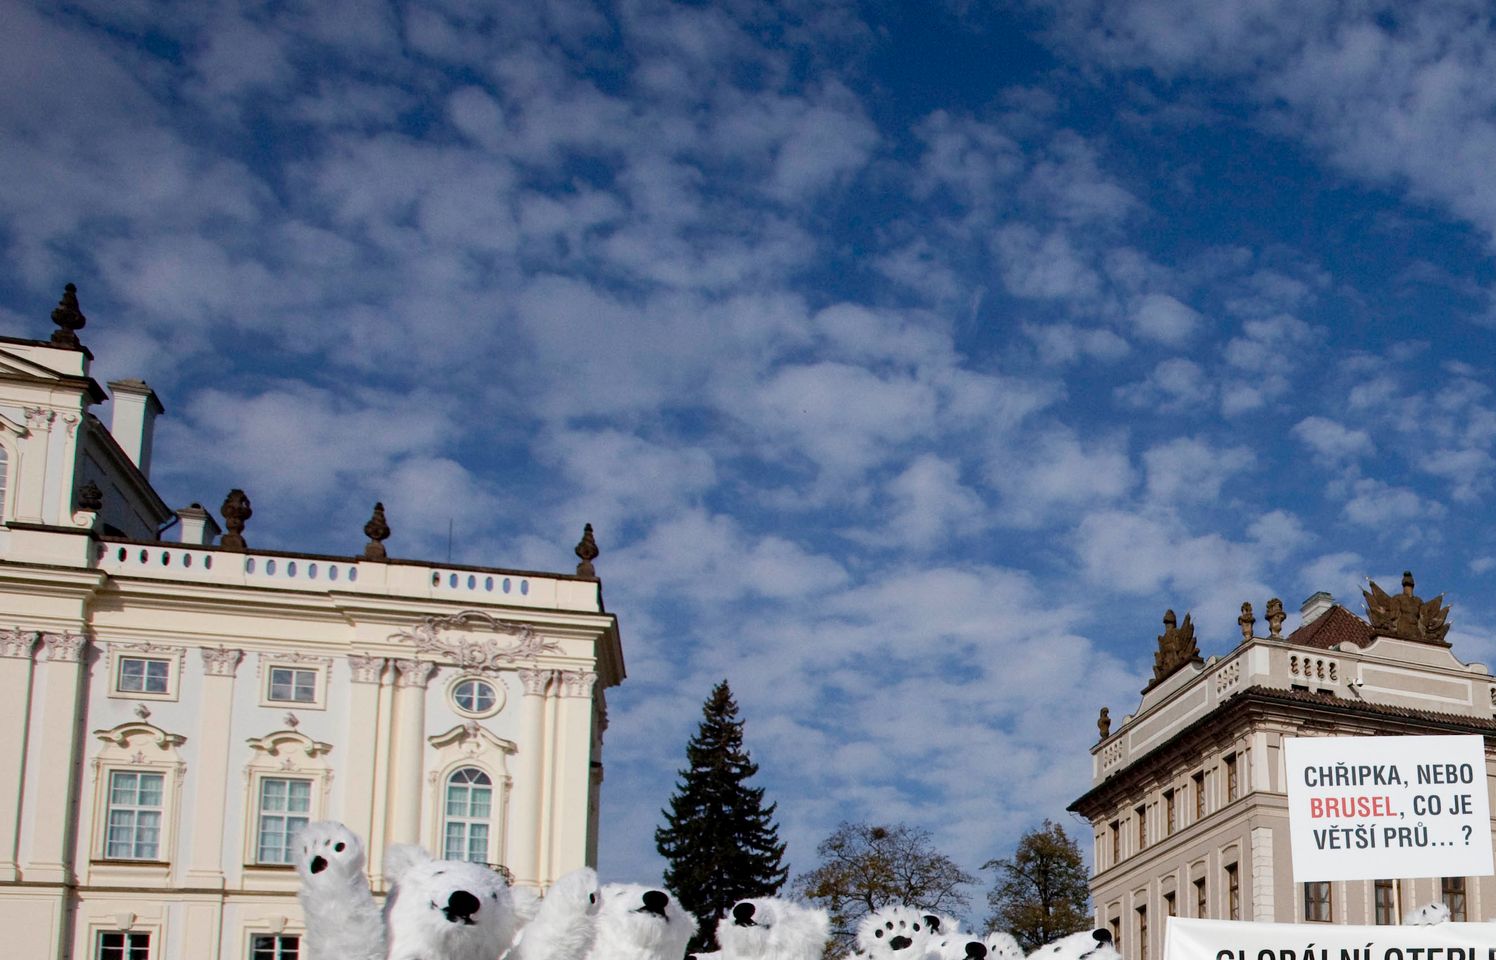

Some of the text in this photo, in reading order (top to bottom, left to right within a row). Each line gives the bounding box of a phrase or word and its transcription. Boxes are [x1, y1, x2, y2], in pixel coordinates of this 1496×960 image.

[1303, 761, 1474, 789] CHŘIPKA, NEBO
[1310, 794, 1473, 820] BRUSEL, CO JE
[1312, 823, 1377, 851] VĚTŠÍ
